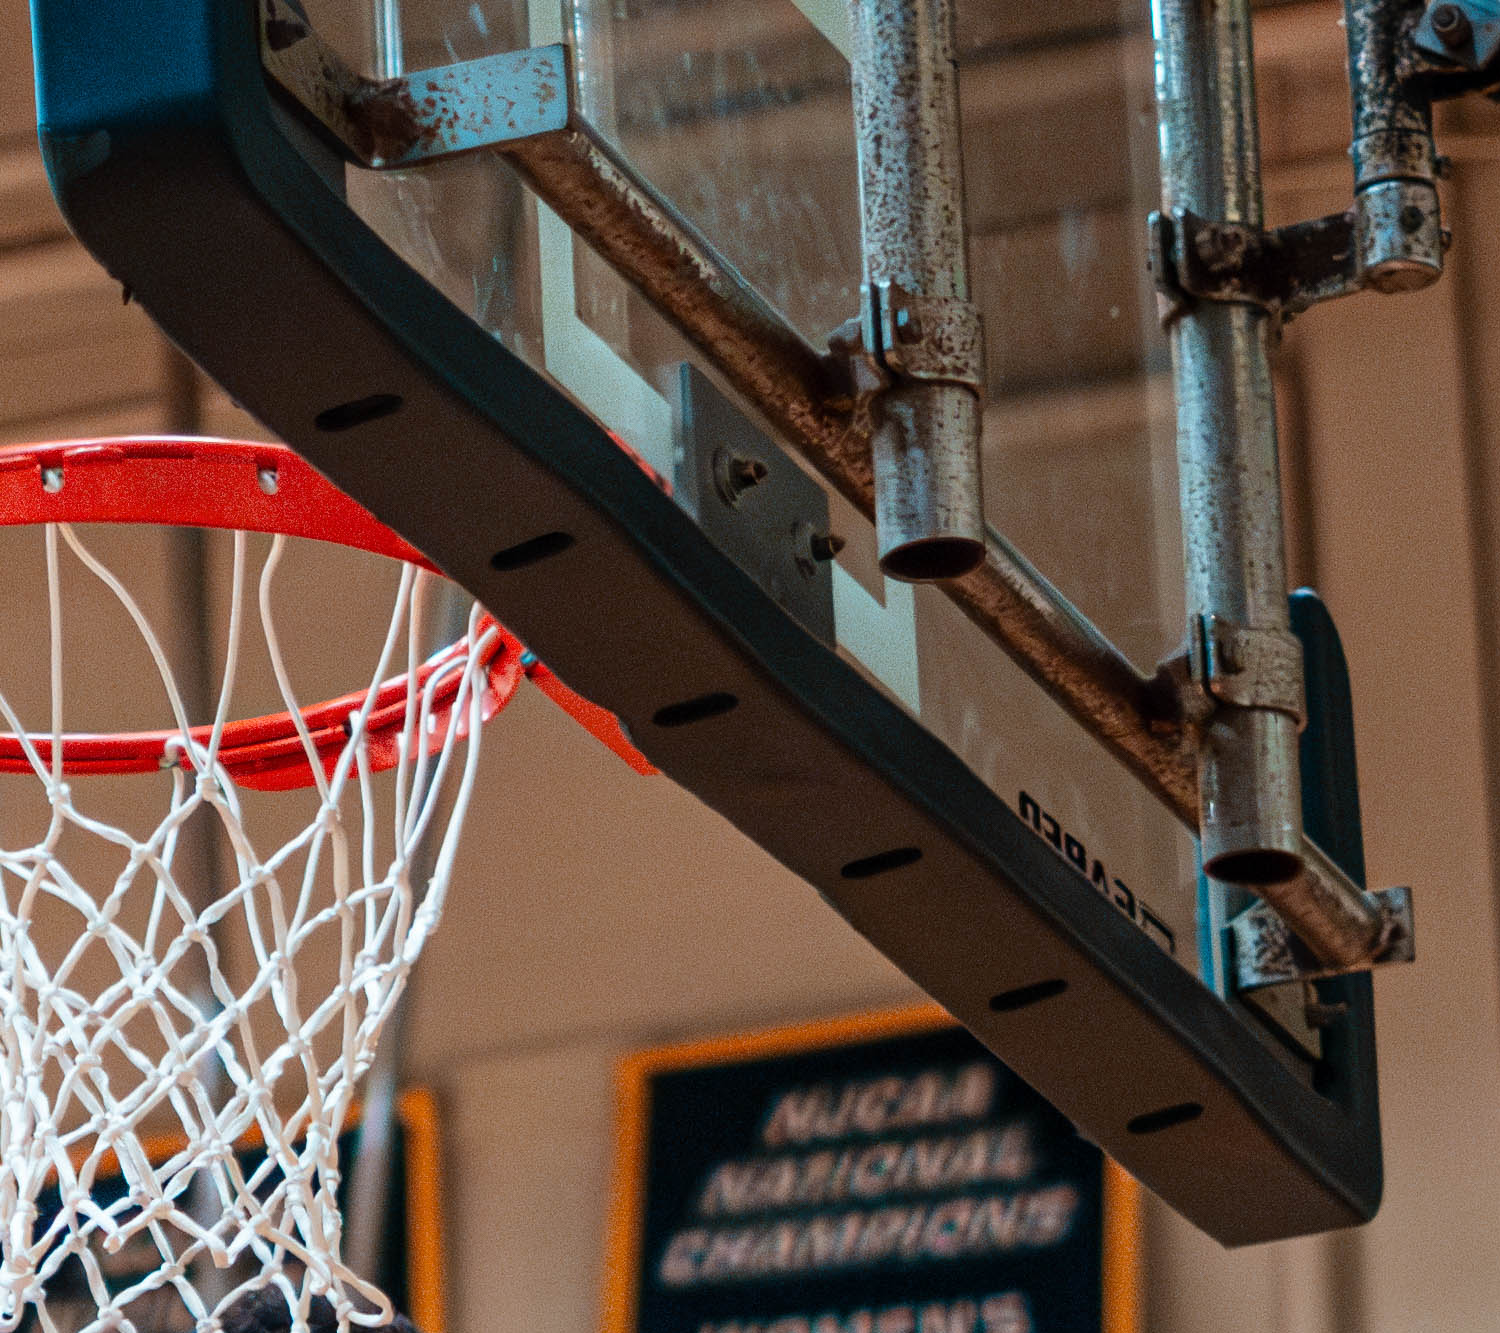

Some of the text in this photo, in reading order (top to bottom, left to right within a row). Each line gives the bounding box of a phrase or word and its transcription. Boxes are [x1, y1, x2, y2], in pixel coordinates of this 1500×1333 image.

[770, 1068, 989, 1138] NJCAA
[710, 1128, 1029, 1208] NATIONAL
[664, 1189, 1074, 1283] CHAMPIONS
